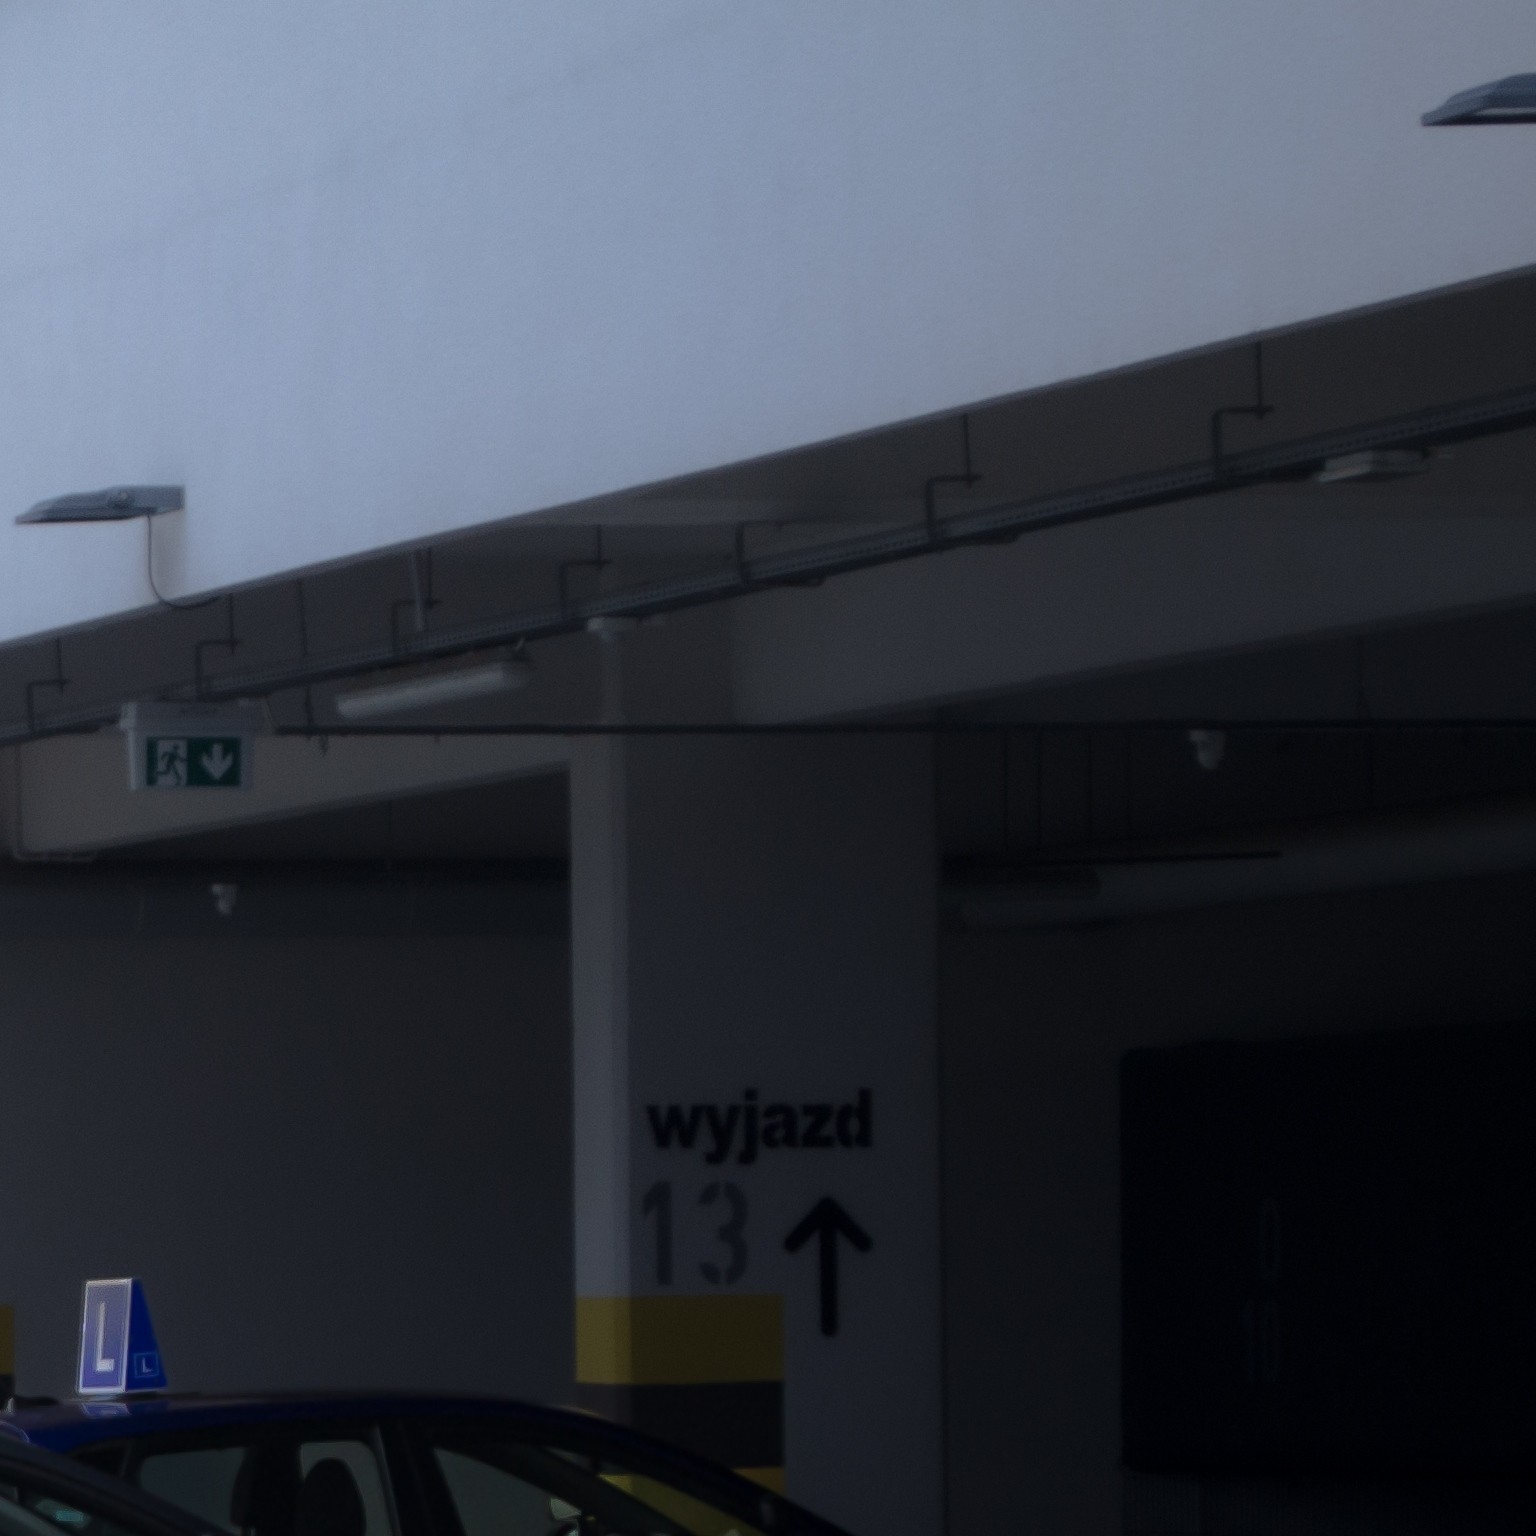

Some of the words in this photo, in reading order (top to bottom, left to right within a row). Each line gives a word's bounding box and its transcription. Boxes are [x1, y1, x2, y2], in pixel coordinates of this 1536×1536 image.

[646, 1088, 872, 1165] wyjazd
[642, 1179, 748, 1286] 13
[95, 1301, 115, 1373] L
[142, 1356, 155, 1373] L
